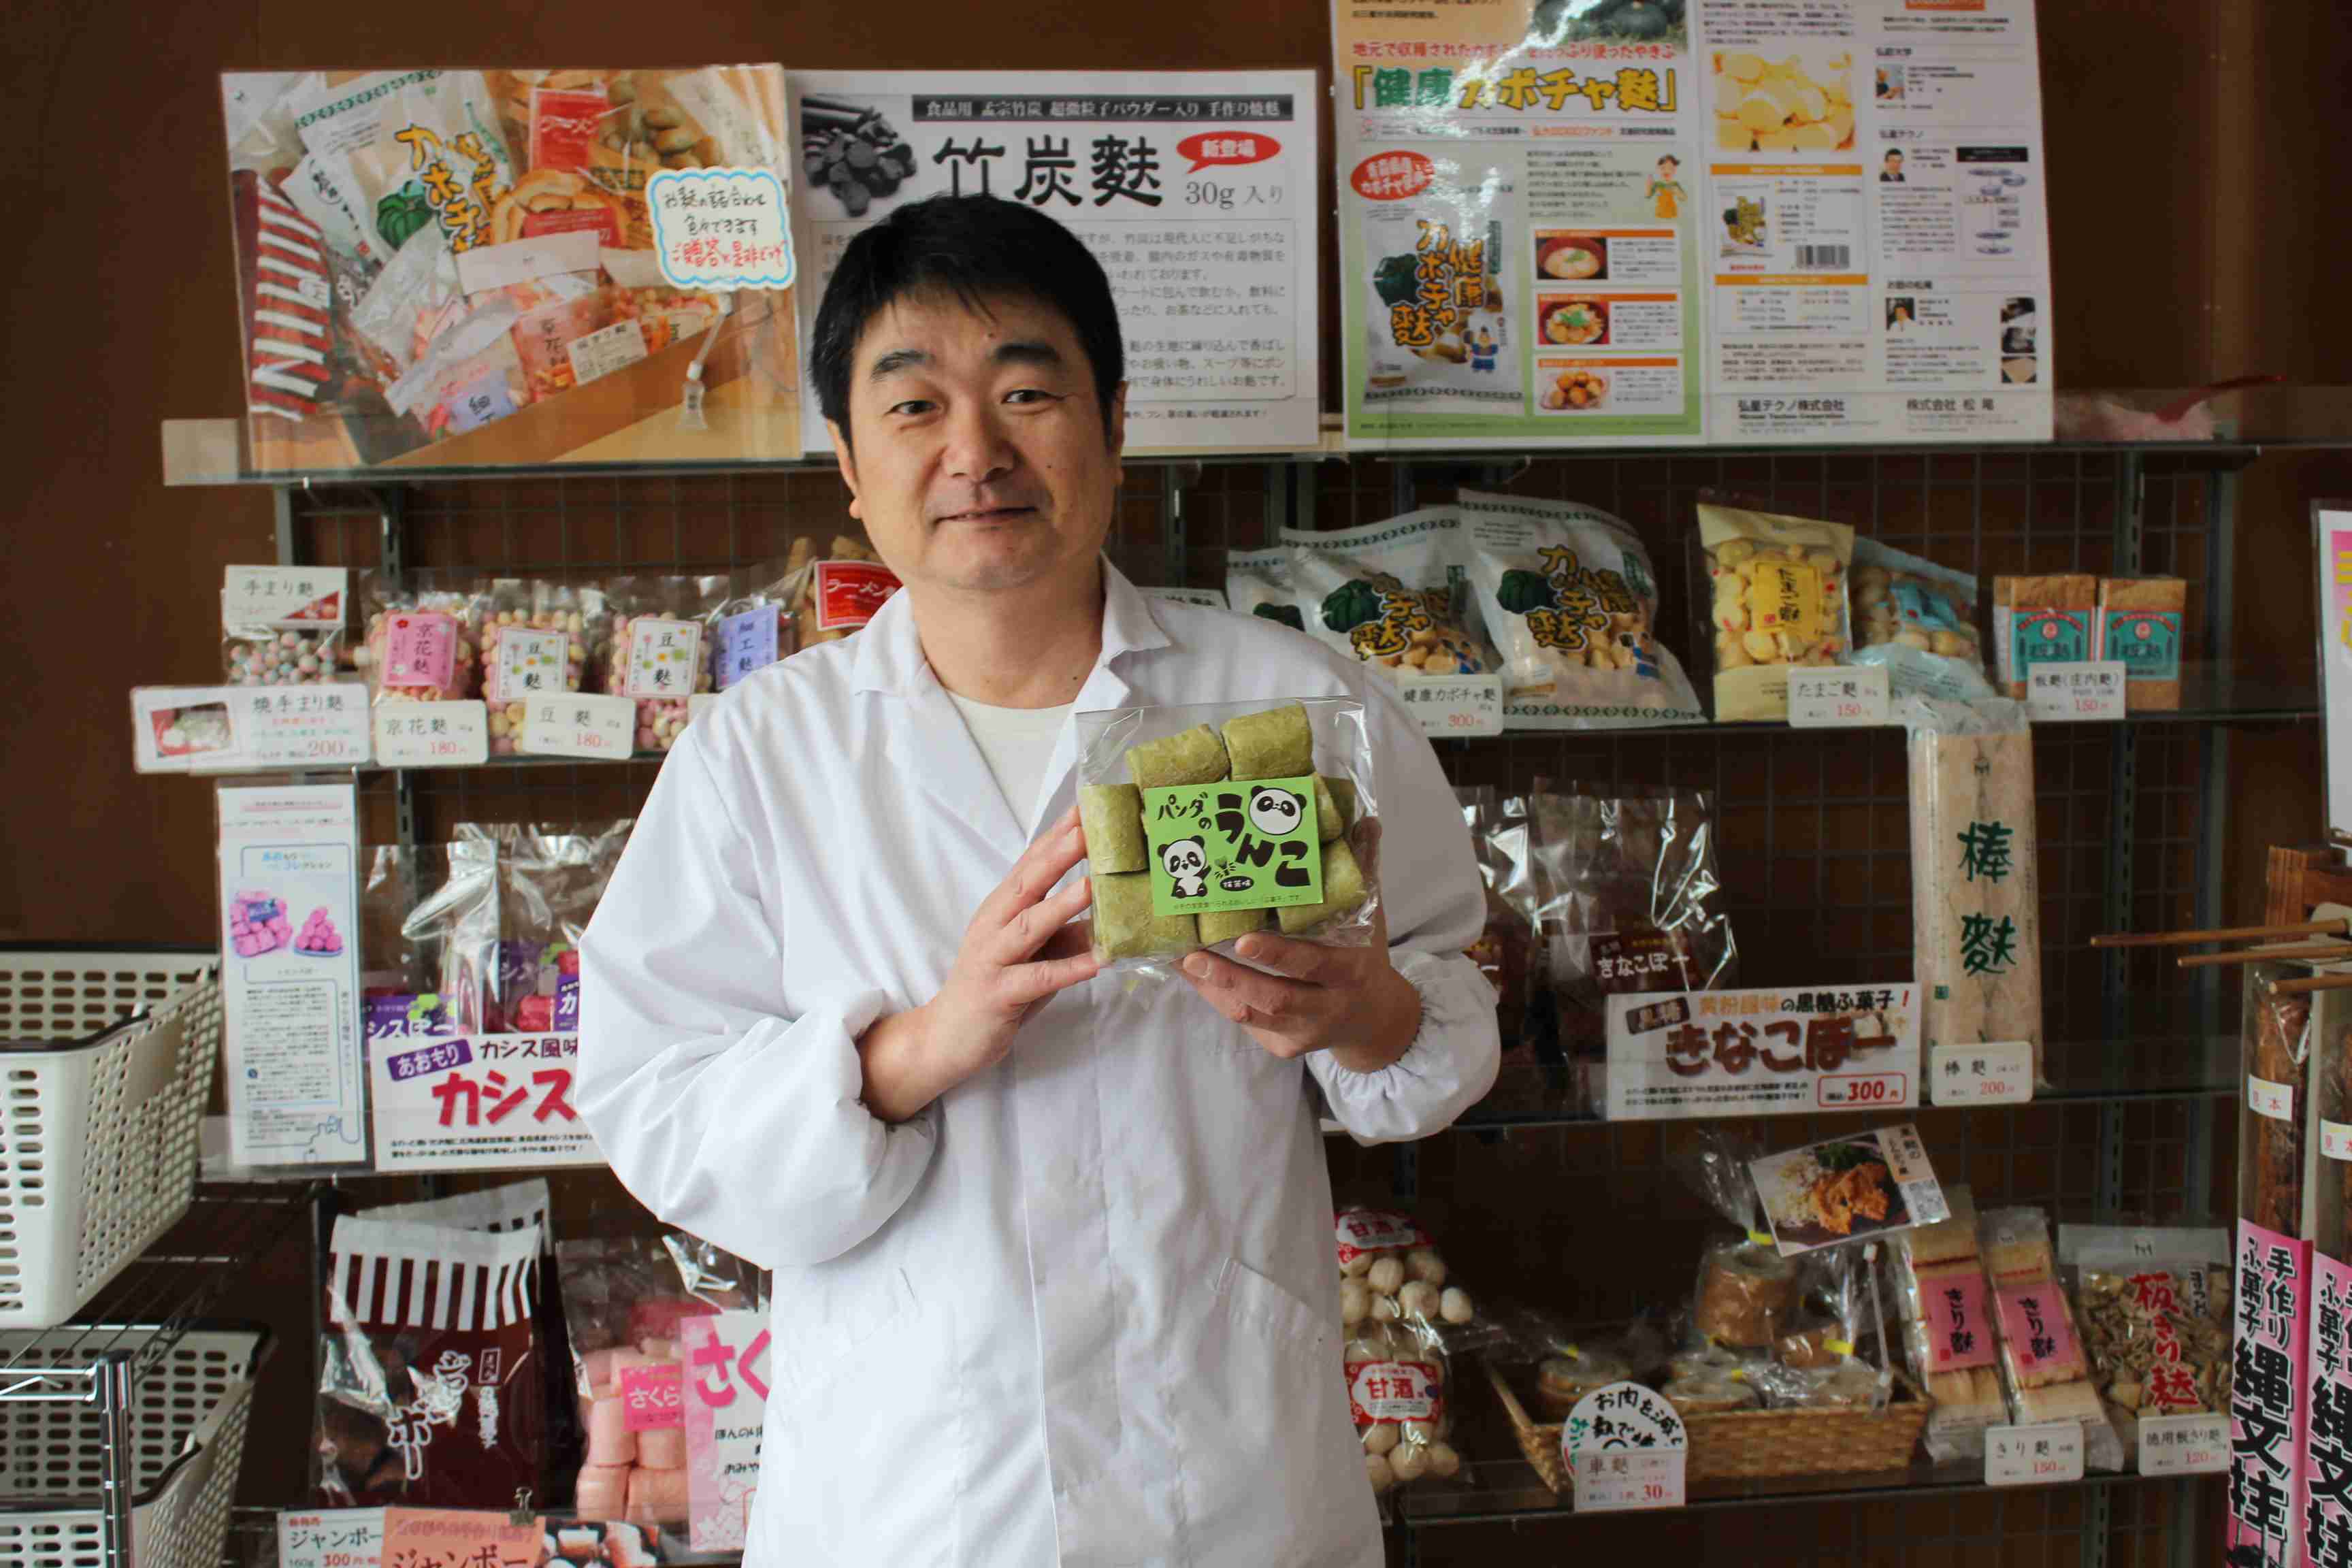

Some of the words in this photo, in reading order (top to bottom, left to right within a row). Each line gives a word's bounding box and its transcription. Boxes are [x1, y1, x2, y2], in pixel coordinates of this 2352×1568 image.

[926, 101, 973, 117] 食品用
[1186, 182, 1235, 210] 30g
[1245, 184, 1284, 206] 入り
[1214, 792, 1311, 888] うんこ
[397, 1043, 461, 1077] あおもり
[431, 1068, 578, 1127] カシス
[2265, 1247, 2296, 1352] 手作り
